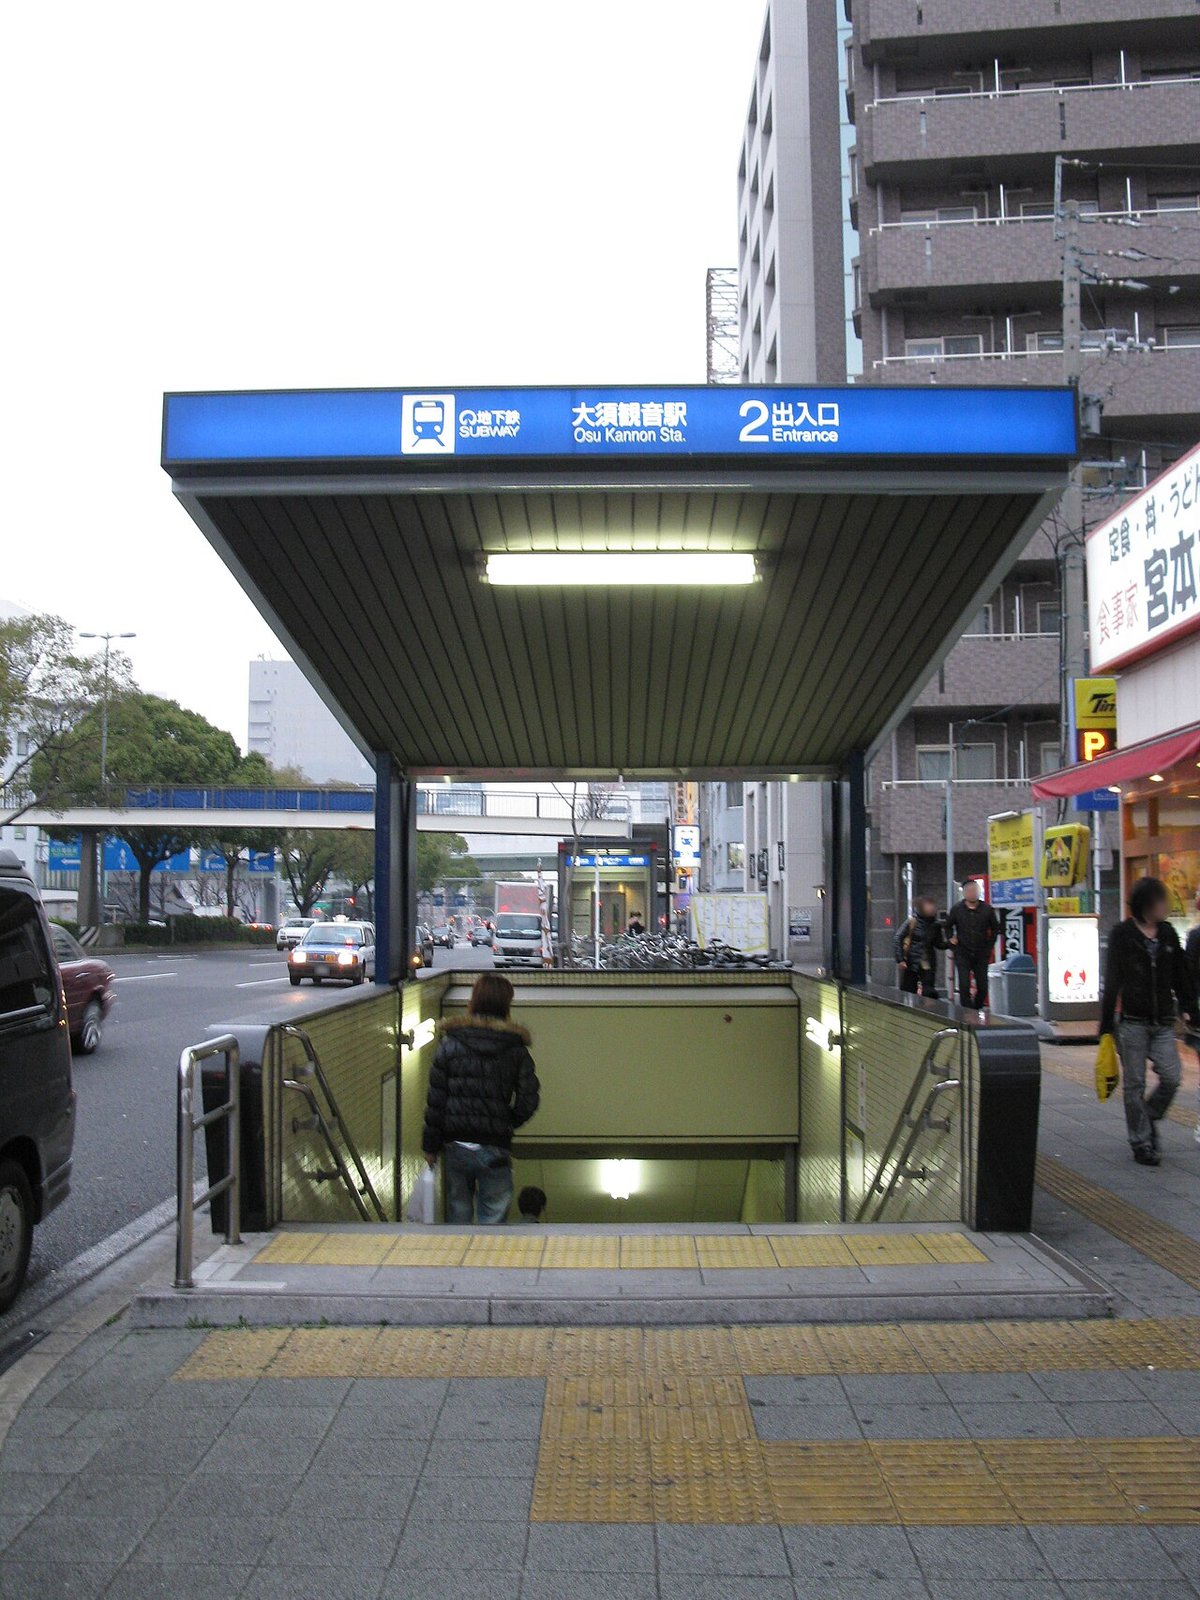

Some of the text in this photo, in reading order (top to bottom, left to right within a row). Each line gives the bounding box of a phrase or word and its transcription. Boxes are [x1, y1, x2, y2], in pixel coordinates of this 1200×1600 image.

[476, 409, 521, 426] 地下鉄
[572, 401, 688, 428] 大須観音駅
[738, 399, 840, 443] 2 出入口
[459, 425, 521, 439] SUBWAY
[574, 427, 686, 443] Osu Kannon Sta.
[772, 428, 839, 443] Entrance
[1143, 529, 1200, 632] 宮本
[1089, 692, 1116, 714] Tim
[1083, 731, 1106, 762] P
[1005, 906, 1024, 959] NESCA
